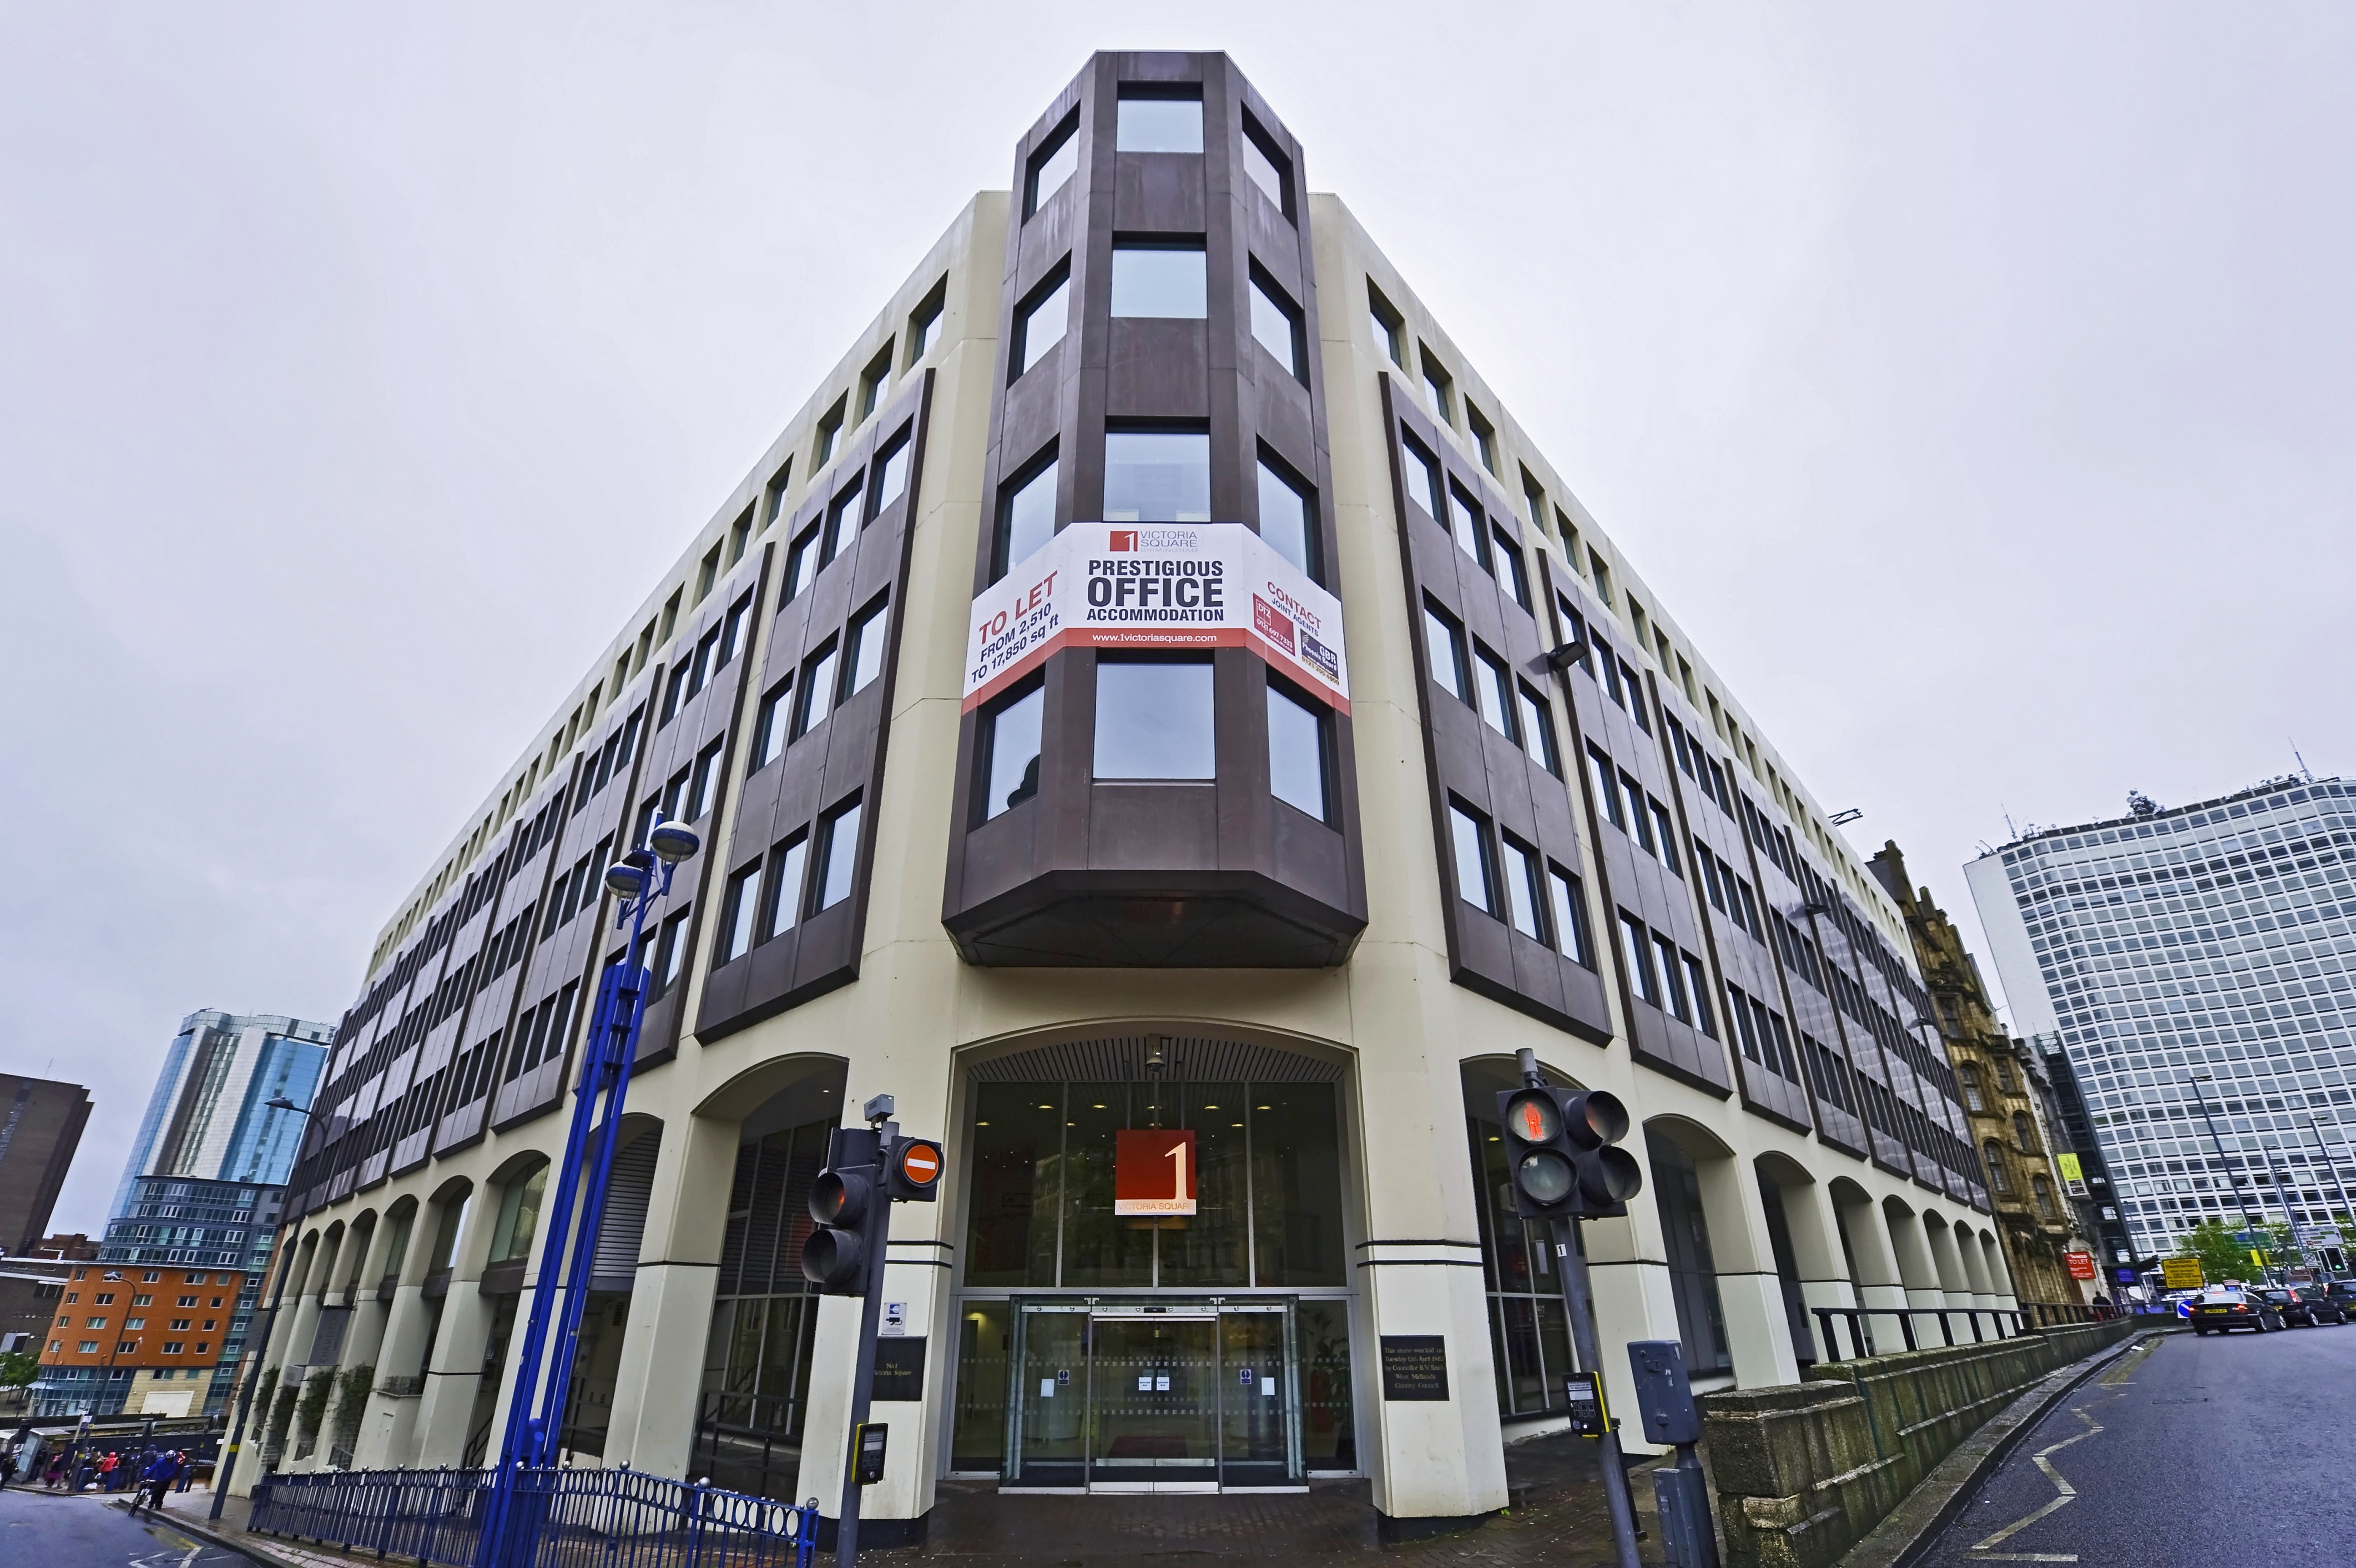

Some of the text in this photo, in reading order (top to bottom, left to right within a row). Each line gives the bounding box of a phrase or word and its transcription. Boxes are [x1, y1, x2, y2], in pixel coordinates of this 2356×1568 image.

[1124, 531, 1197, 551] 1 VICTORIA
[1088, 560, 1223, 576] PRESTIGIOUS
[1087, 577, 1223, 607] OFFICE
[1268, 582, 1321, 629] CONTACT
[979, 570, 1058, 644] TO LET
[1087, 608, 1224, 621] ACCOMMODATION
[1258, 603, 1271, 617] DTZ
[1272, 598, 1319, 637] JOINT AGENTS
[980, 602, 1051, 662] FROM 2,510
[1092, 633, 1217, 643] www.1victoriasquare.com
[1256, 618, 1269, 631] 0121
[1280, 634, 1294, 648] 7333
[971, 613, 1059, 683] TO 17,850 sq ft
[1302, 642, 1322, 661] Phoenix
[1322, 658, 1337, 671] Beard
[1302, 656, 1314, 668] 0121
[1319, 646, 1336, 664] GBR
[1164, 1142, 1188, 1200] 1
[1558, 1246, 1563, 1256] 1
